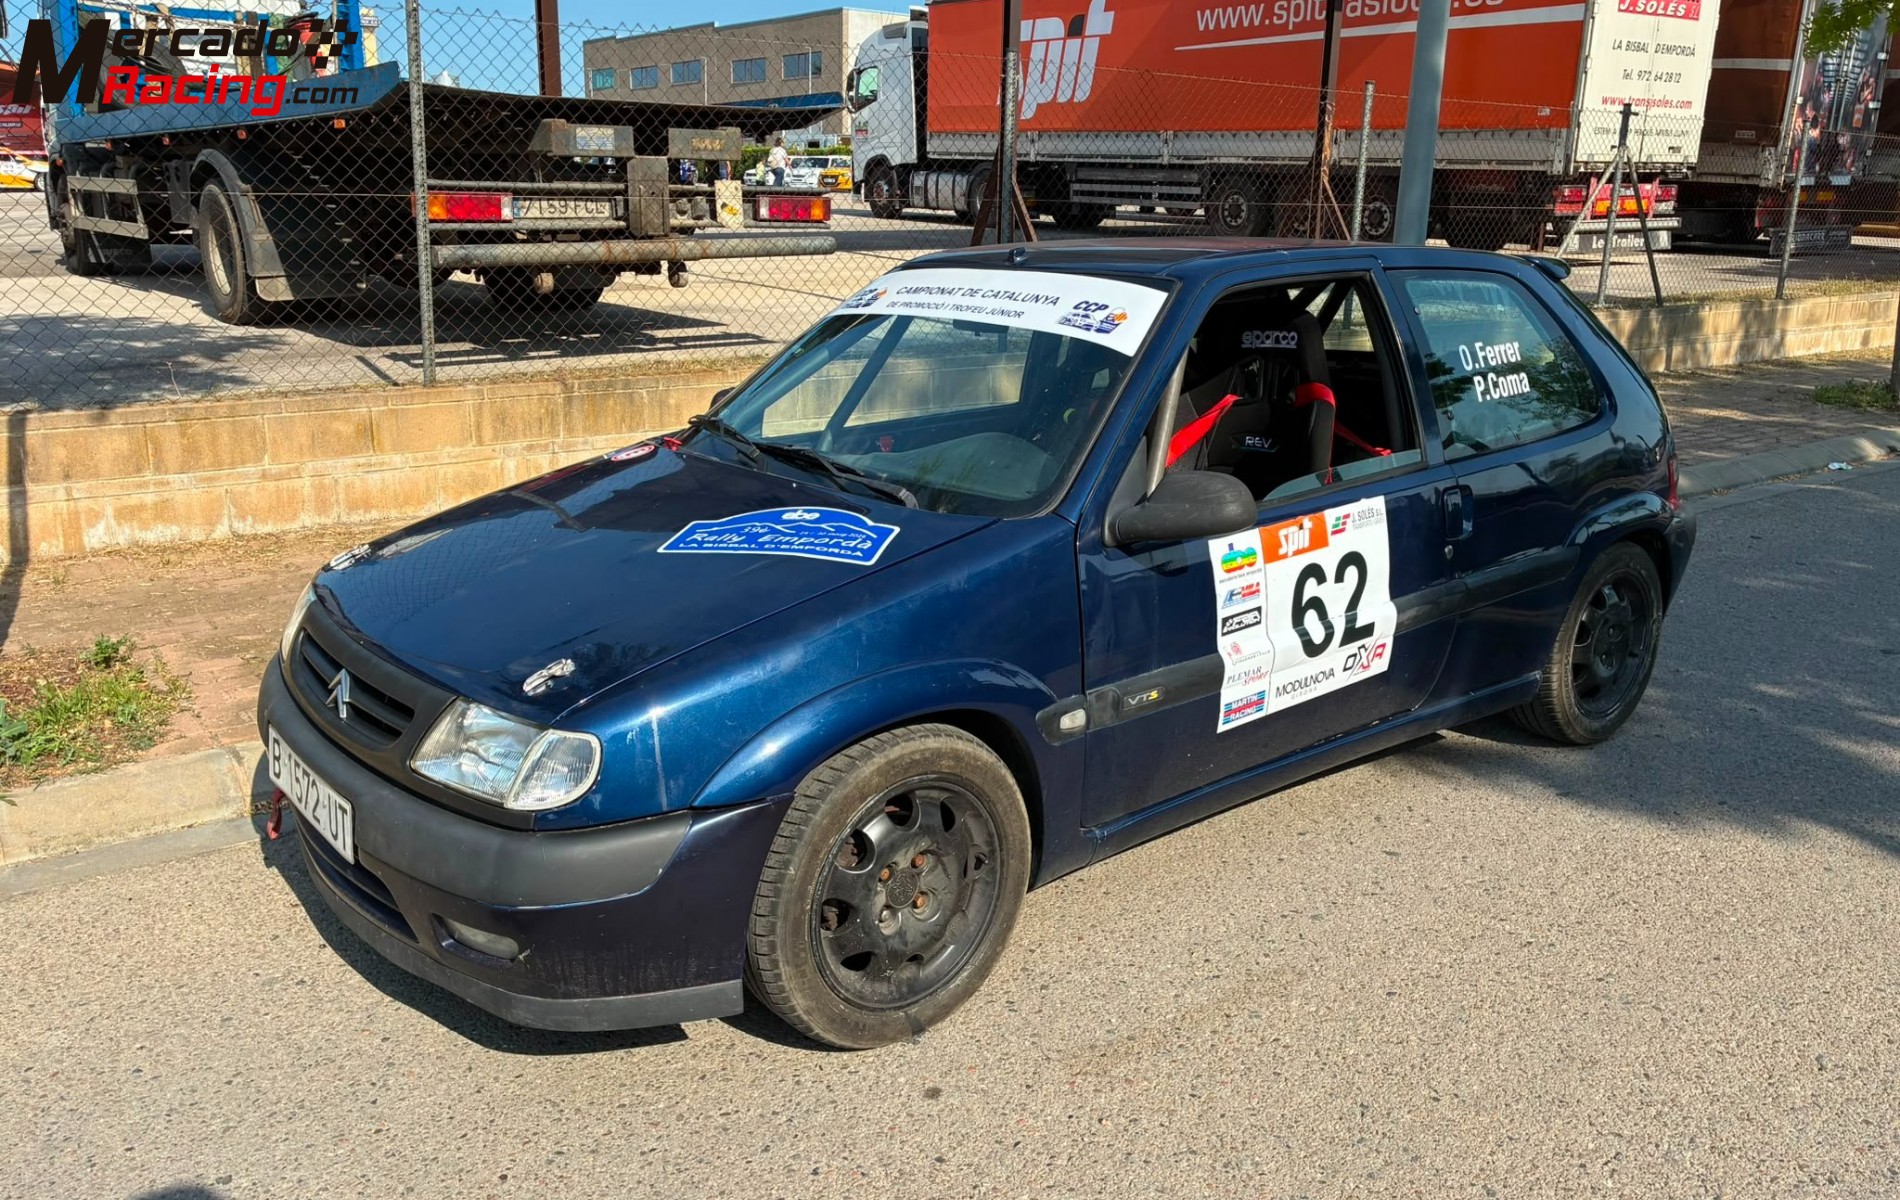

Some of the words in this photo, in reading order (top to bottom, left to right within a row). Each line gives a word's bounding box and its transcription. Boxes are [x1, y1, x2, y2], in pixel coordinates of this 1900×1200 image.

[1612, 39, 1623, 51] LA
[1625, 40, 1650, 54] BISBAL
[1622, 69, 1634, 81] Tel.
[1637, 70, 1652, 82] 972
[1601, 95, 1693, 112] wwwtransjsoles.com
[523, 197, 568, 216] 7159
[1592, 235, 1605, 249] Le
[896, 286, 965, 297] CAMPIONAT
[960, 287, 983, 298] DE
[980, 289, 1061, 307] CATALUNYA
[897, 300, 946, 310] PROMOCIÓ
[949, 303, 989, 314] TROFEU
[985, 306, 1026, 319] JÚNIOR
[1072, 300, 1110, 313] CCP
[1458, 340, 1522, 371] O.Ferrer
[1473, 371, 1531, 403] P.Coma
[1245, 435, 1273, 449] REV
[685, 533, 747, 544] Rally
[756, 534, 873, 550] Empordà
[1278, 517, 1313, 558] spit
[1291, 551, 1376, 659] 62
[1127, 689, 1159, 706] VTS
[272, 736, 281, 780] B
[288, 752, 321, 826] 1572
[327, 792, 348, 852] UT
